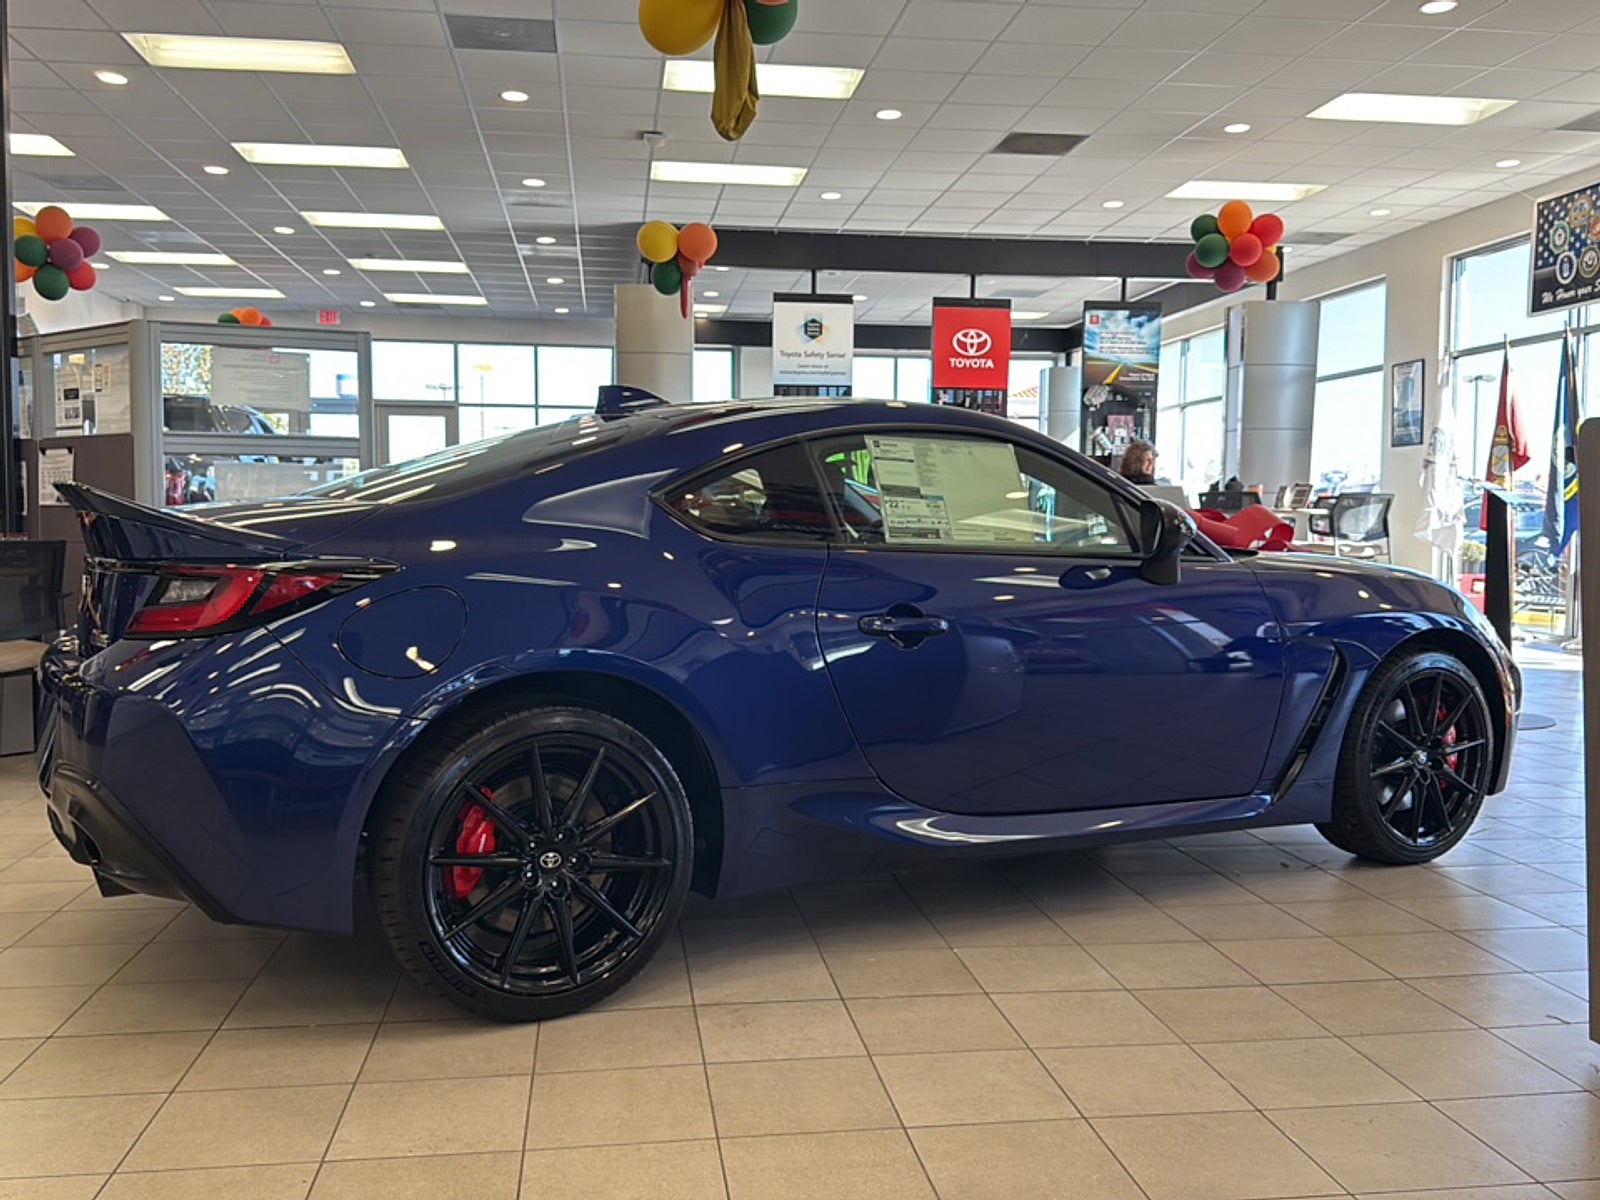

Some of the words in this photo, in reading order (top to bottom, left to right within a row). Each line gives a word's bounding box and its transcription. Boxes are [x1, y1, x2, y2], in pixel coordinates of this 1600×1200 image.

[780, 350, 802, 360] Toyota
[804, 350, 824, 361] Safety
[827, 351, 846, 359] Sense
[948, 357, 994, 369] TOYOTA
